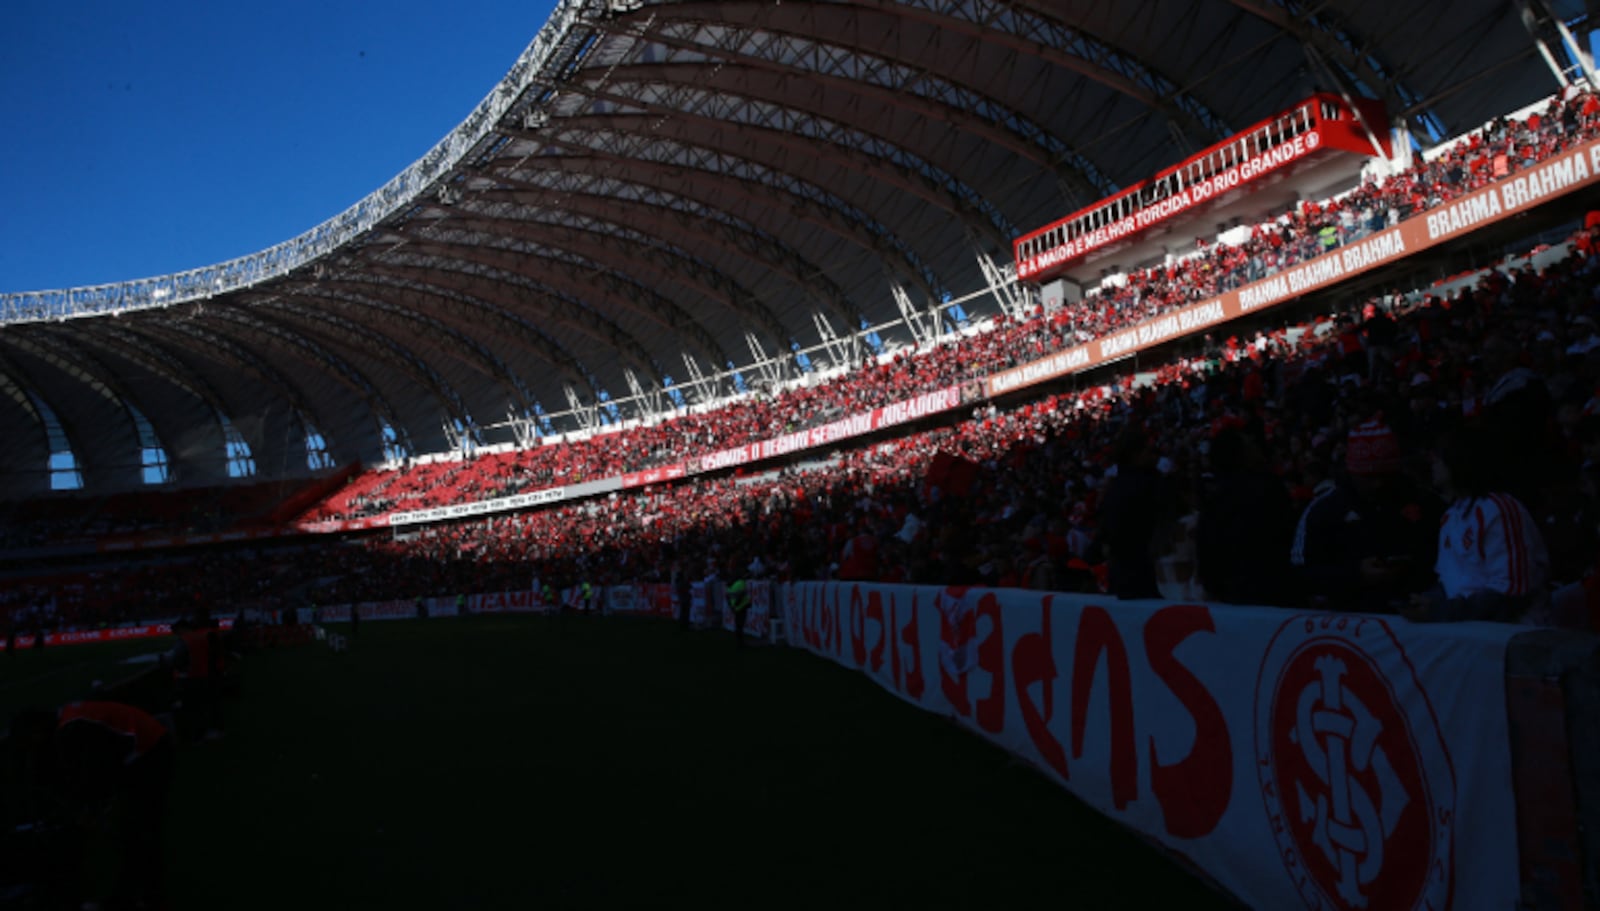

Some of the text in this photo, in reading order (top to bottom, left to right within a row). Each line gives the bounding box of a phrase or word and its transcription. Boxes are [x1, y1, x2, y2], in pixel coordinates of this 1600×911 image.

[1028, 135, 1305, 273] A MAIOR E MELHOR TORCIDA DO RIO GRANDE
[1427, 189, 1502, 240] BRAHMA
[1502, 152, 1589, 211] BRAHMA
[1238, 229, 1405, 311] BRAHMA BRAHMA BRAHMA
[878, 389, 948, 427] JOGADOR
[849, 583, 925, 701] FICO
